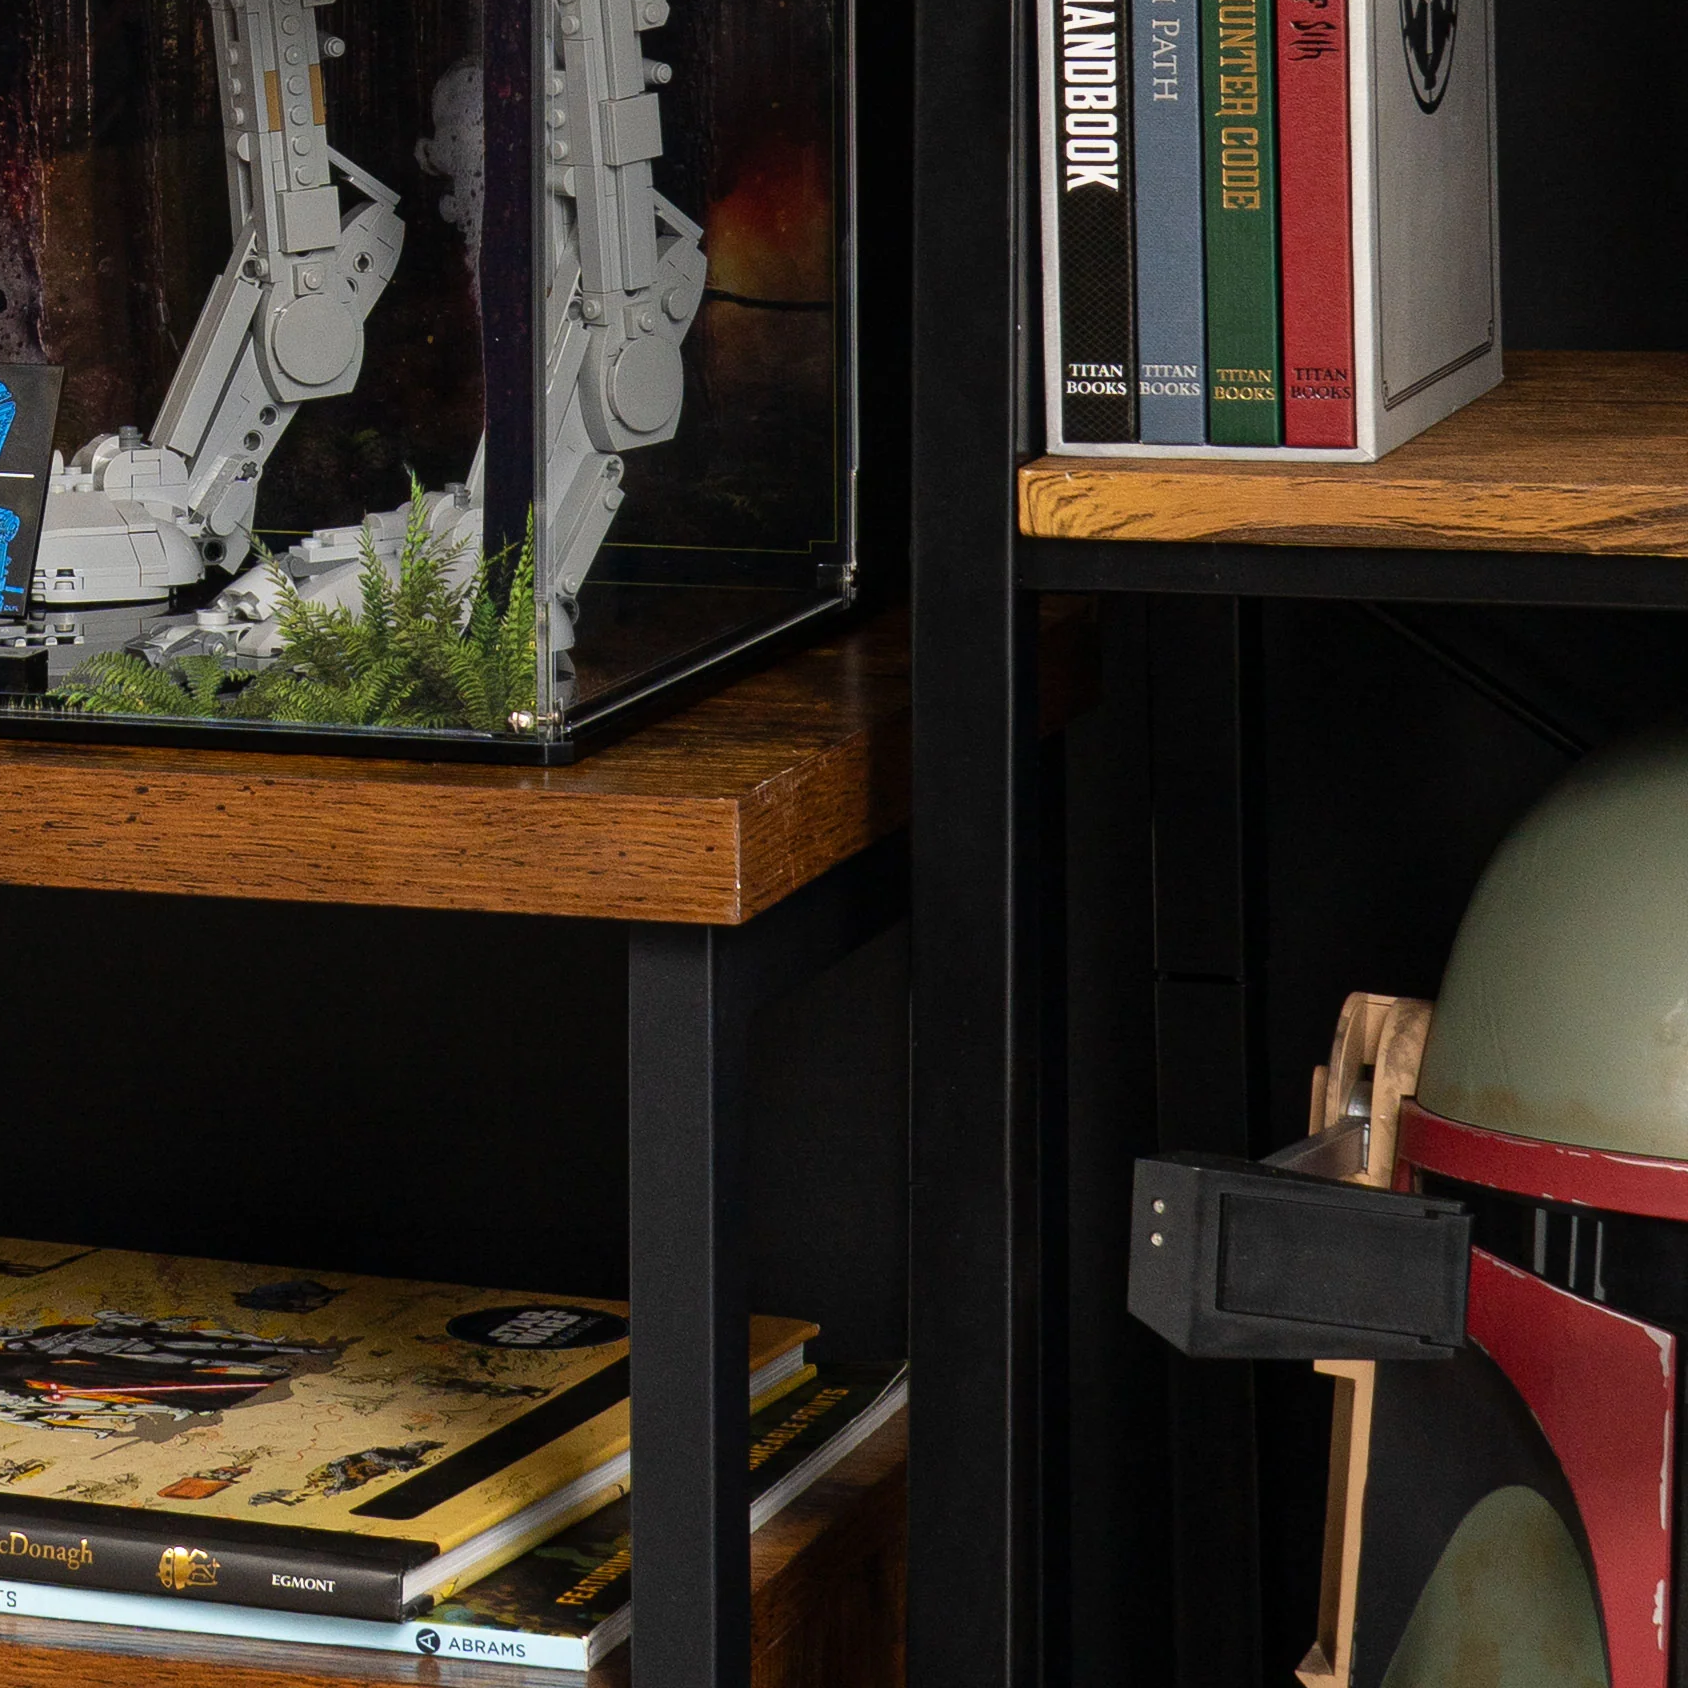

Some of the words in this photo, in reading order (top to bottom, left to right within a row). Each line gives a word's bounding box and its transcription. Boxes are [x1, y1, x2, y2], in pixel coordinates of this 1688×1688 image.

[1152, 18, 1180, 101] PATH
[1221, 127, 1260, 210] CODE
[1068, 363, 1123, 378] TITAN
[1142, 364, 1197, 378] TITAN
[1216, 368, 1272, 383] TITAN
[1292, 367, 1347, 381] TITAN
[1066, 380, 1127, 396] BOOKS
[1139, 381, 1201, 396] BOOKS
[1214, 386, 1275, 401] BOOKS
[1290, 385, 1352, 400] BOOKS
[271, 1573, 336, 1594] EGMONT
[449, 1636, 526, 1658] ABRAMS
